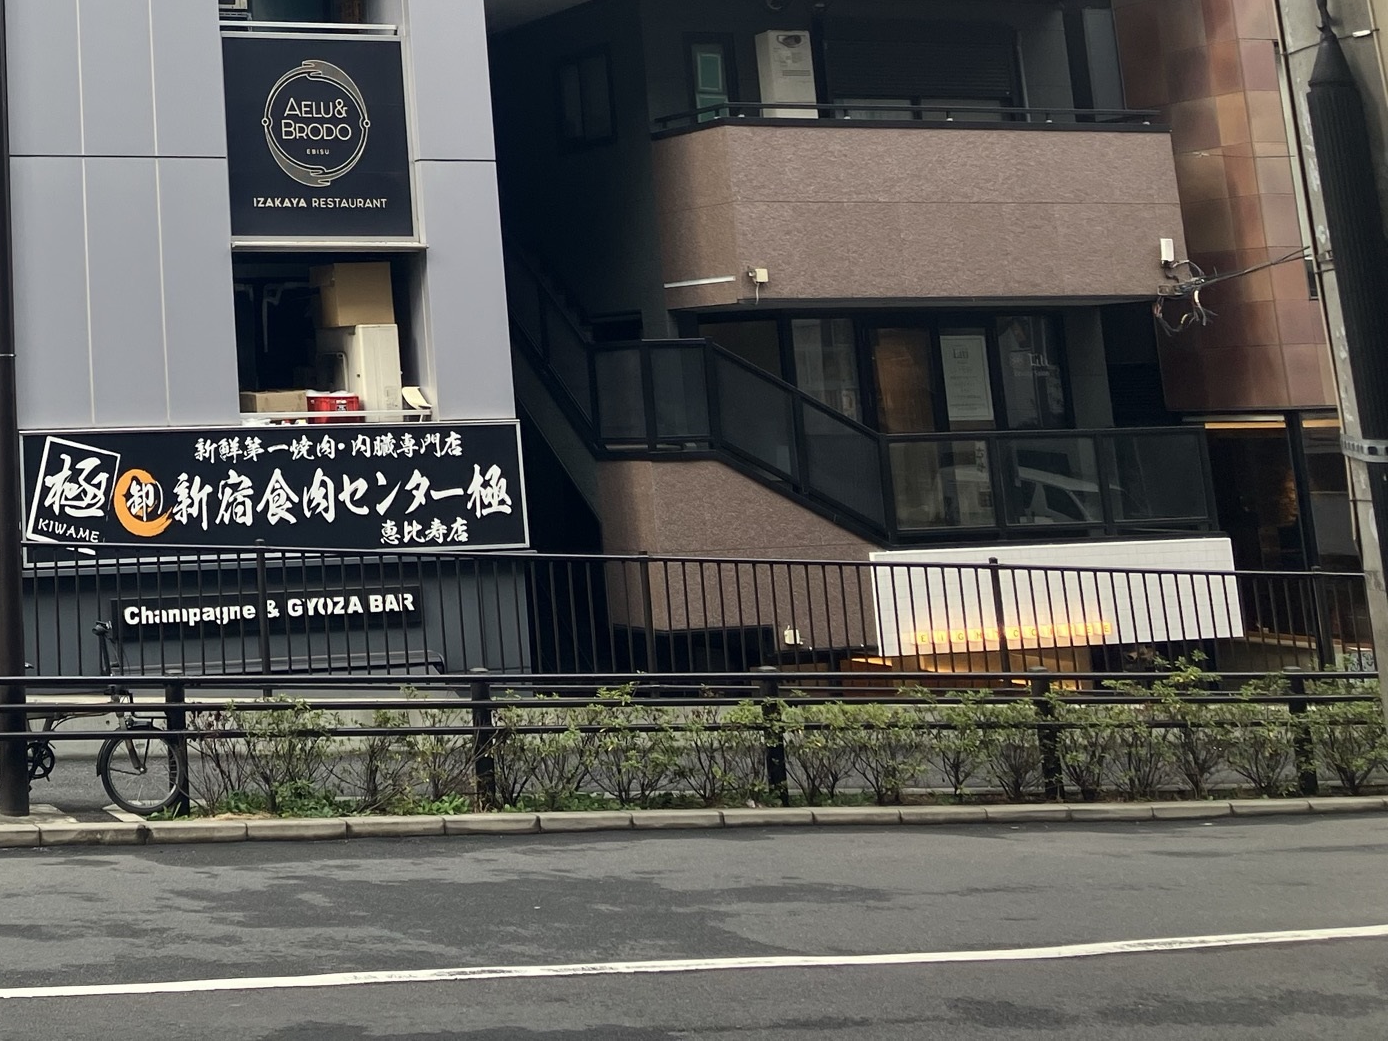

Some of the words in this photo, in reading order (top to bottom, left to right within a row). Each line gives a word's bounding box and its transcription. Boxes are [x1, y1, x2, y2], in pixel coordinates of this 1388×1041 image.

[283, 97, 348, 119] AELU&
[281, 119, 352, 141] BRODO
[306, 148, 330, 156] EBISU
[253, 197, 307, 208] IZAKAYA
[312, 198, 387, 209] RESTAURANT
[44, 453, 110, 518] 極
[172, 463, 512, 531] 新宿食肉センター極
[37, 518, 100, 543] KIWAME
[380, 517, 469, 545] 恵比寿店
[123, 603, 256, 627] Champagne
[266, 599, 280, 618] &
[286, 595, 364, 617] GYOZA
[368, 593, 415, 614] BAR
